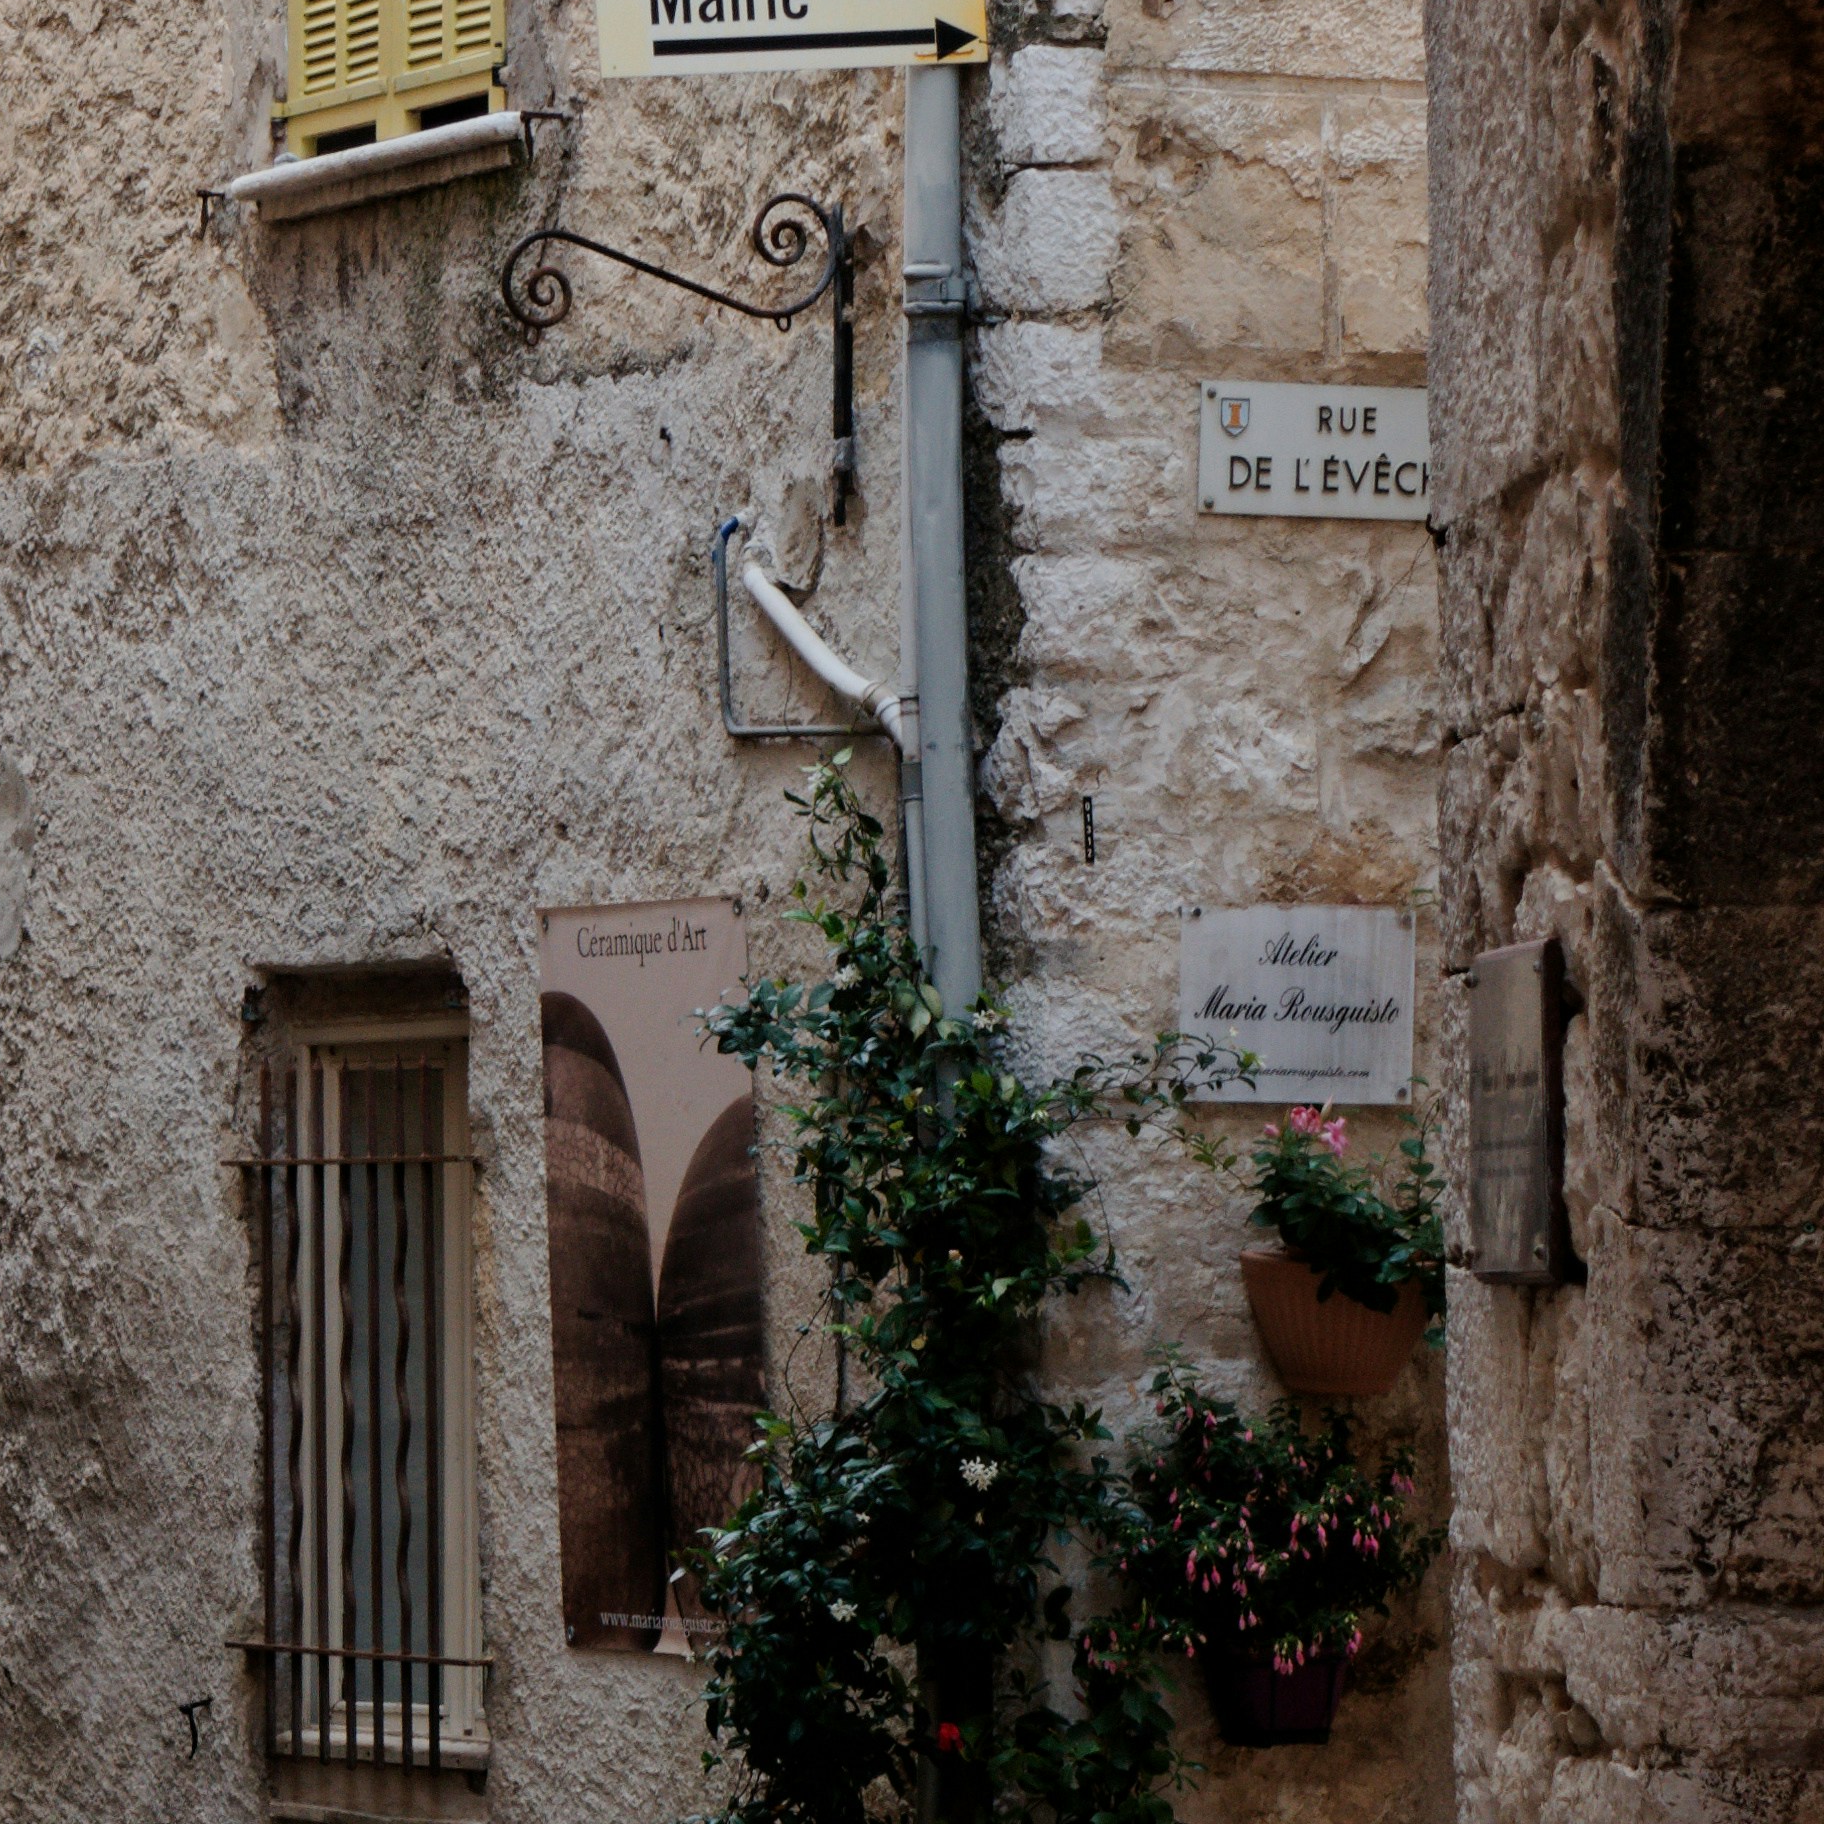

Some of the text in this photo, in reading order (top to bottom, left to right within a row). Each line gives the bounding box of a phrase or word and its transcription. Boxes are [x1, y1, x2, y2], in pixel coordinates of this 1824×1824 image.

[1318, 405, 1377, 434] RUE
[1228, 455, 1273, 491] DE
[577, 916, 707, 968] Céramique d'Art
[1259, 931, 1339, 967] Atelier
[1194, 983, 1268, 1021] Maria
